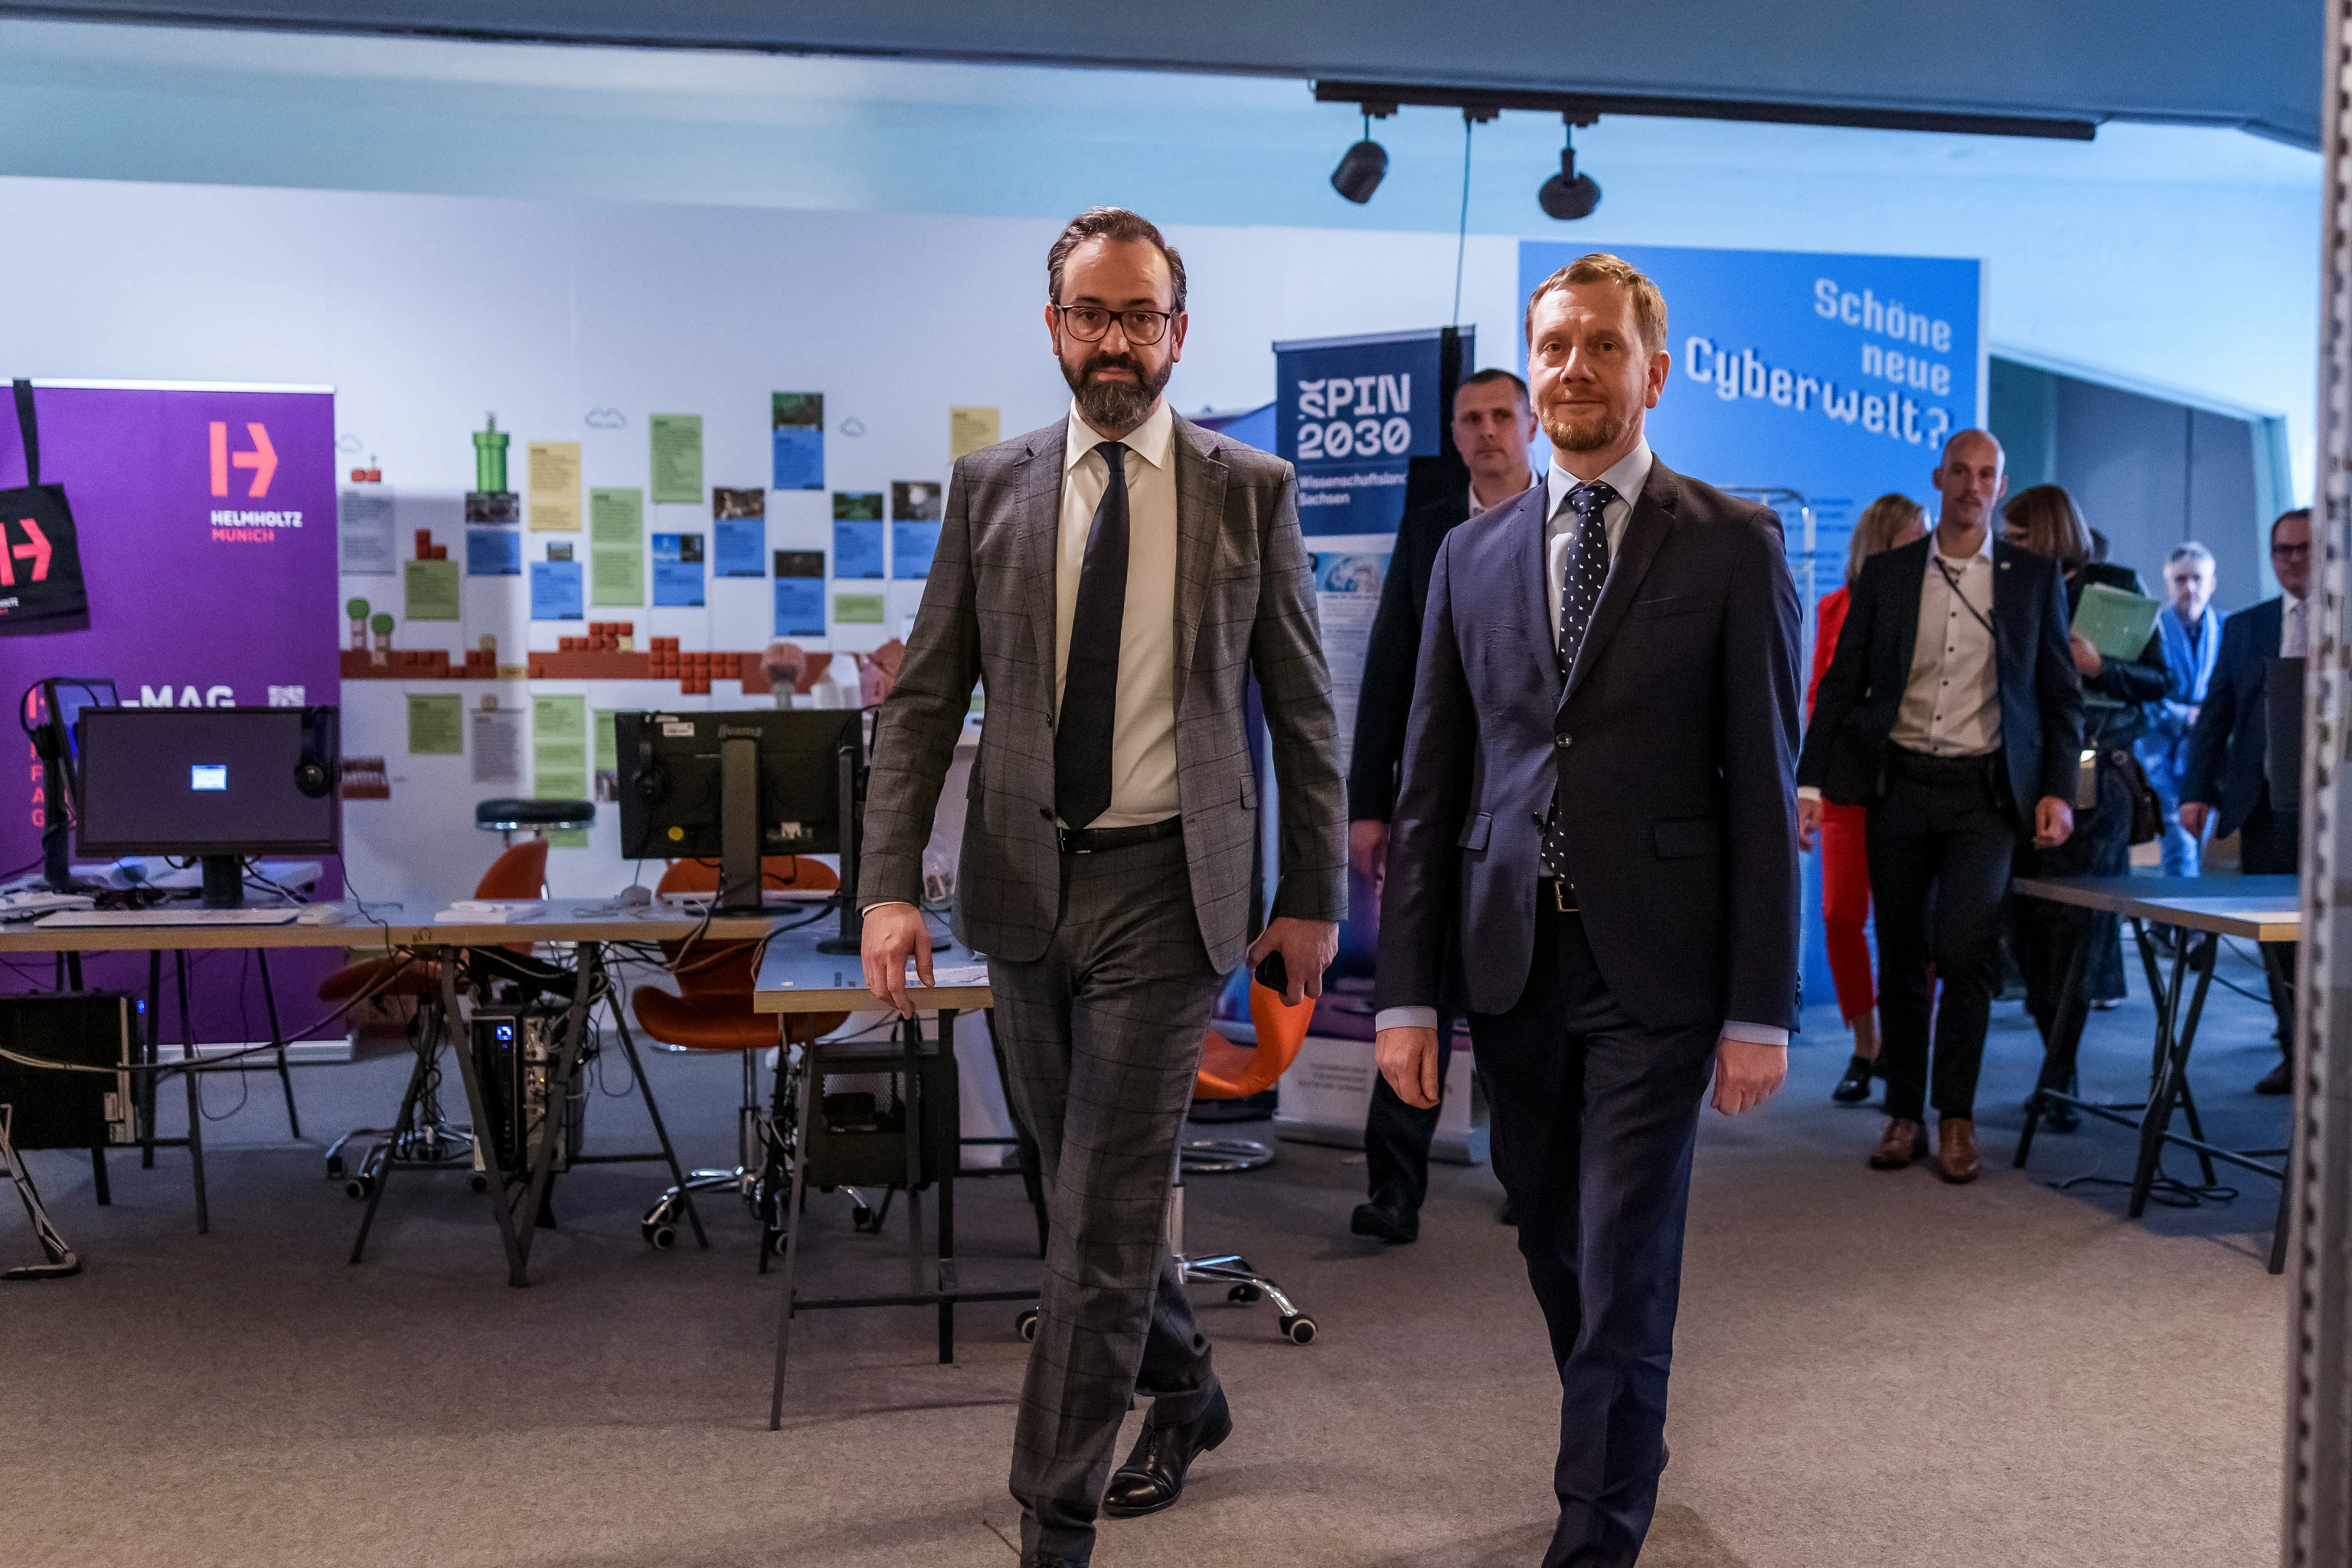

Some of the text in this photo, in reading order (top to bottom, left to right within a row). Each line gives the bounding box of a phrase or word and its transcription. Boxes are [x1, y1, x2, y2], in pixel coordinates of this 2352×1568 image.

[1814, 277, 1952, 353] Schöne
[1686, 335, 1952, 450] Cyberwelt?
[1862, 342, 1951, 397] neue
[1297, 417, 1412, 459] 2030
[211, 509, 303, 528] HELMHOLTZ
[211, 528, 275, 542] MUNICH
